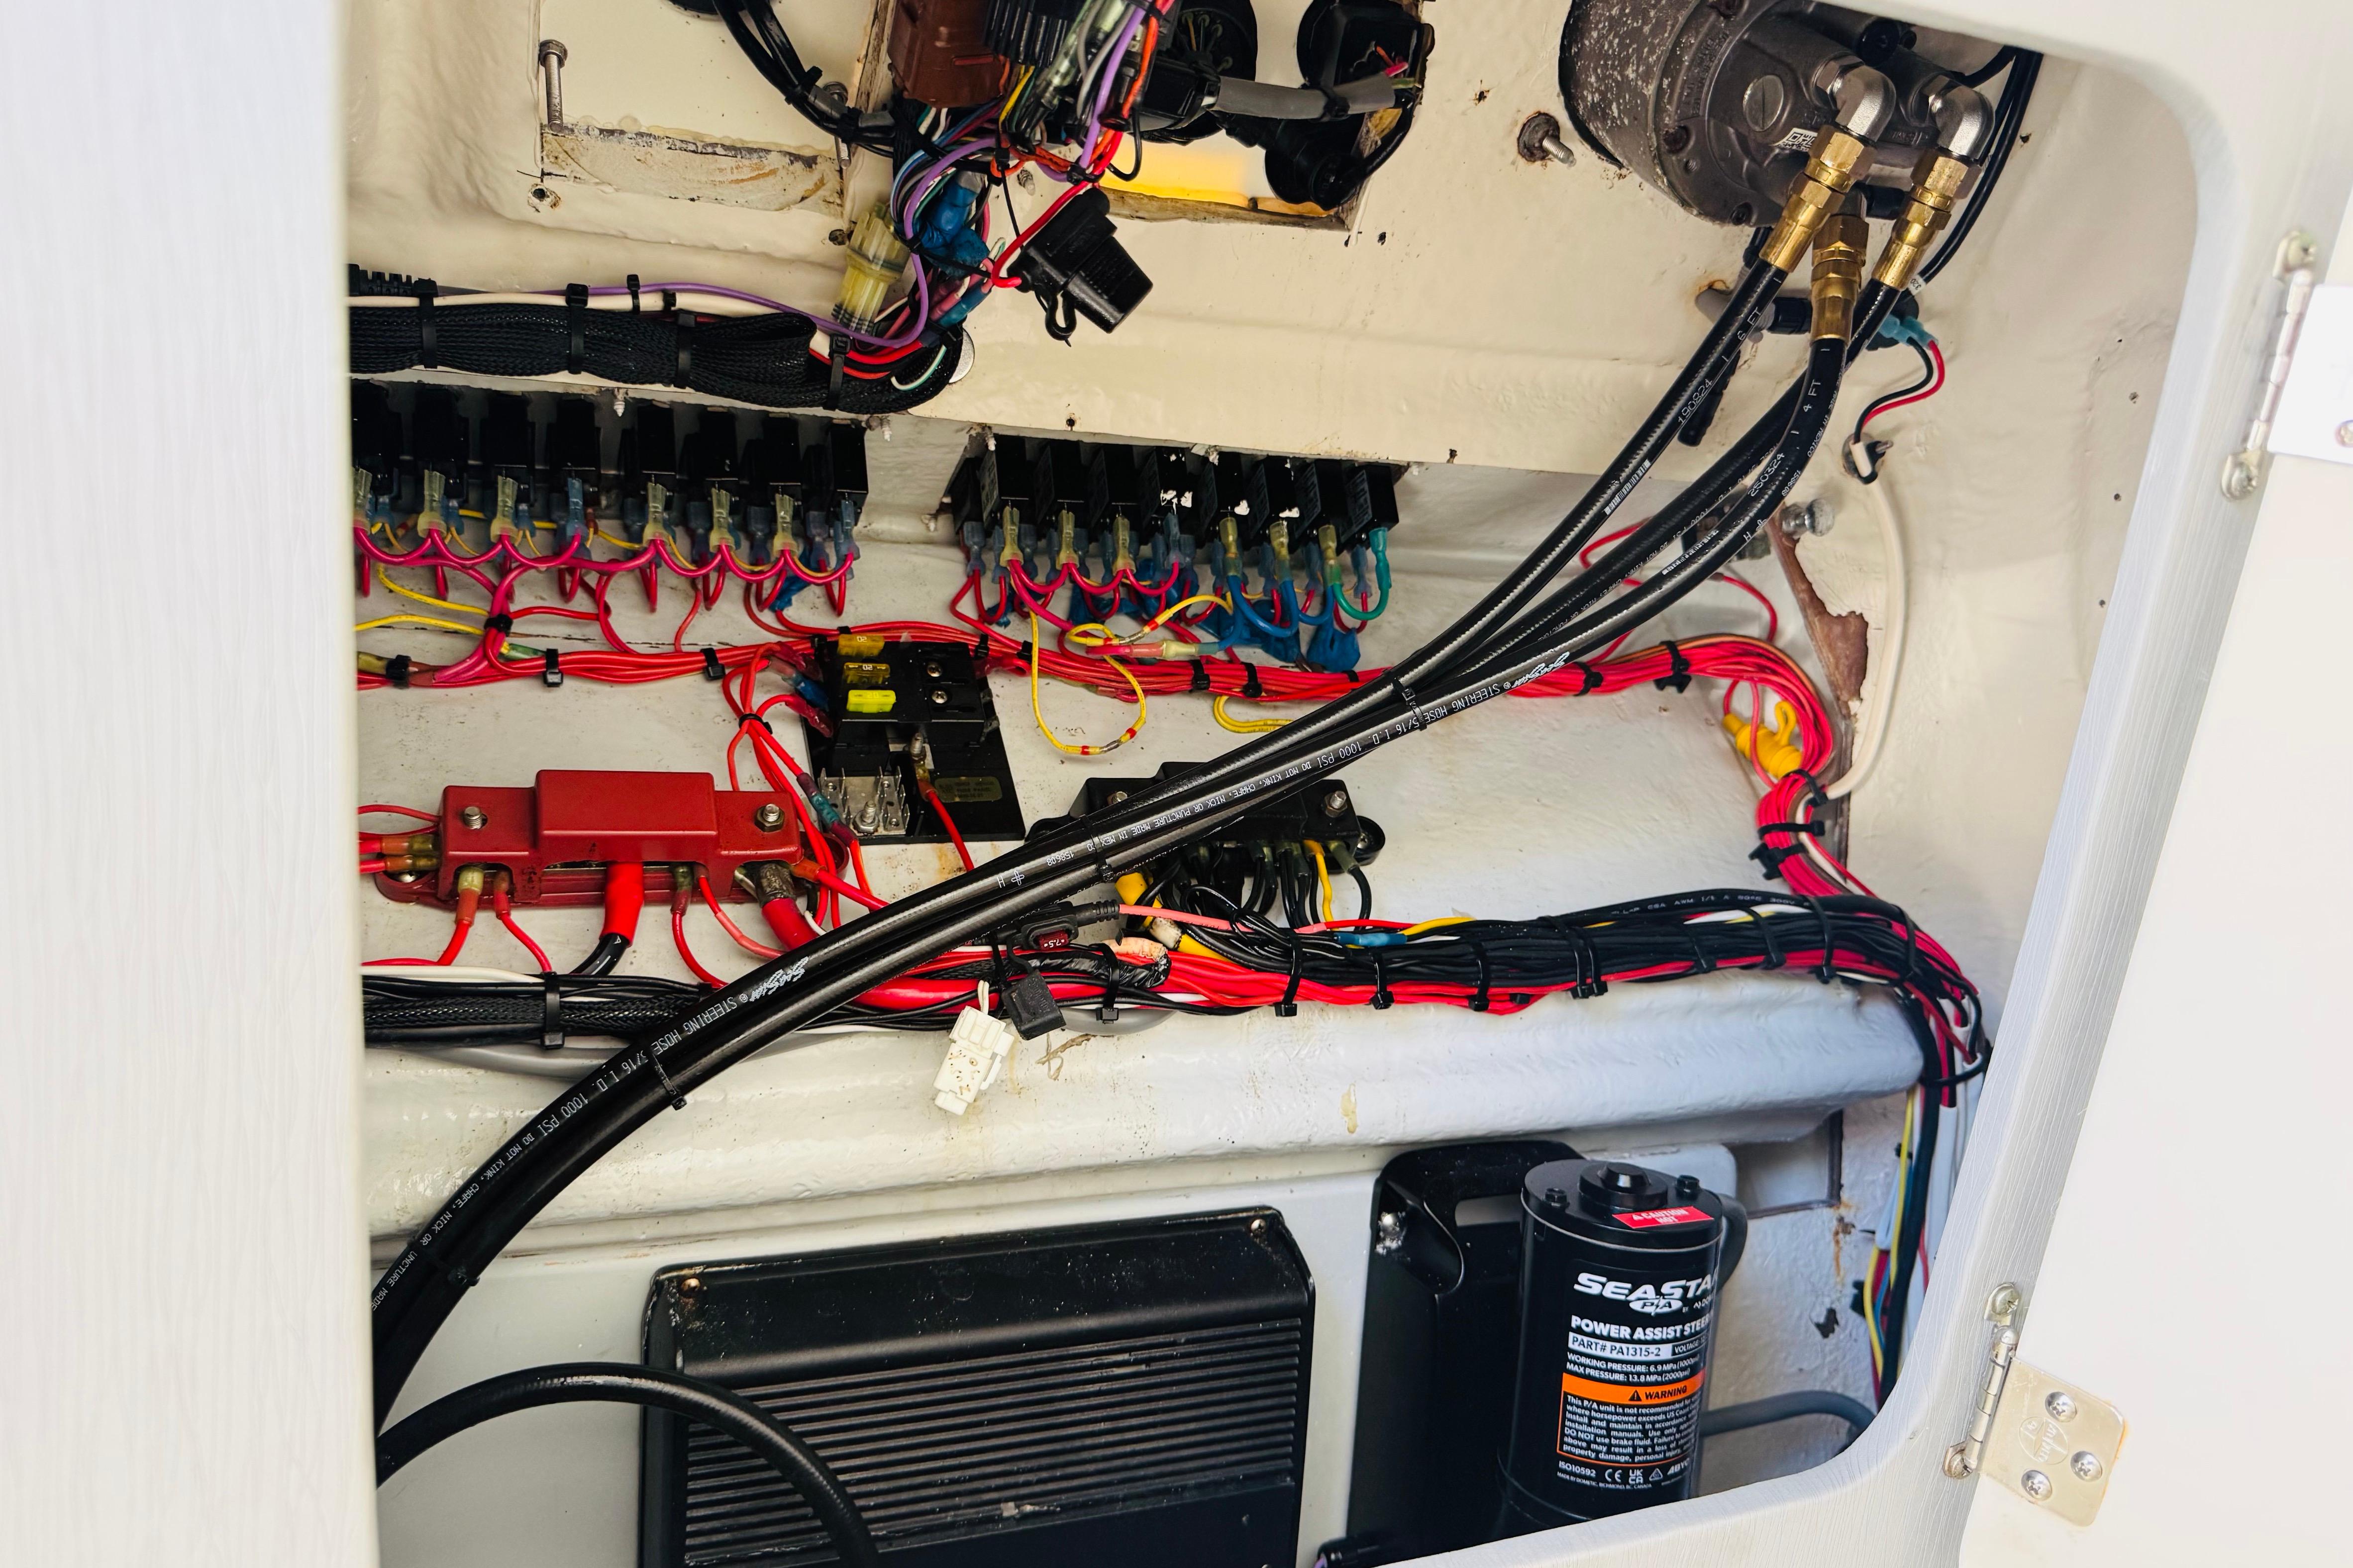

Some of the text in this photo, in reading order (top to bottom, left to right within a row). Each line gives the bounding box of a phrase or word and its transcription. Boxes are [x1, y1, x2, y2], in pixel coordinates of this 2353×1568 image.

[1678, 379, 1713, 424] 190824
[1747, 307, 1761, 325] FT
[1748, 453, 1785, 497] 250324
[1803, 403, 1812, 412] 4
[1808, 379, 1821, 396] FT
[1807, 427, 1825, 458] MEXICO
[1743, 531, 1753, 544] H
[1452, 684, 1500, 711] STEERING
[1423, 705, 1447, 723] HOSE
[1396, 717, 1420, 735] 5/16
[1368, 729, 1390, 745] I.D.
[1339, 741, 1361, 759] 1000
[1301, 762, 1312, 770] DO
[1318, 752, 1334, 768] PSI
[1259, 773, 1282, 787] KINK,
[1285, 767, 1299, 778] NOT
[1229, 784, 1255, 798] CHAFE,
[1194, 803, 1203, 813] OR
[1207, 797, 1226, 808] NICK
[1155, 807, 1191, 828] PUNCTURE
[1120, 832, 1128, 841] IN
[1131, 823, 1150, 836] MADE
[1046, 851, 1074, 866] 158608
[997, 875, 1006, 888] H
[1049, 938, 1062, 948] 7.5
[683, 996, 737, 1035] STEERING
[650, 1029, 682, 1055] HOSE
[592, 1071, 619, 1092] I.D.
[561, 1093, 588, 1118] 1000
[537, 1114, 560, 1137] PSI
[523, 1133, 535, 1145] DO
[506, 1143, 522, 1161] NOT
[481, 1159, 505, 1180] KINK,
[452, 1183, 479, 1208] CHAFE,
[431, 1211, 452, 1233] NICK
[1641, 1209, 1688, 1219] CAUTION
[420, 1233, 432, 1246] OR
[387, 1251, 418, 1287] UNCTURE
[1571, 1313, 1711, 1341] POWER ASSIST STEER
[1572, 1336, 1661, 1357] PART# PA1315-2
[1567, 1352, 1606, 1368] WORKING
[1607, 1362, 1648, 1372] PRESSURE:
[1662, 1362, 1676, 1371] MPa
[1567, 1361, 1584, 1374] MAX
[1585, 1368, 1627, 1381] PRESSURE:
[1645, 1373, 1662, 1382] MPa
[1662, 1368, 1690, 1381] (2000psi)
[1644, 1385, 1687, 1400] WARNING
[1567, 1395, 1582, 1405] This
[1583, 1399, 1598, 1410] P/A
[1600, 1403, 1615, 1412] unit
[1639, 1399, 1684, 1414] recommended
[1567, 1404, 1590, 1416] where
[1592, 1410, 1637, 1422] horsepower
[1638, 1413, 1665, 1422] exceeds
[1565, 1420, 1606, 1435] installation
[1611, 1429, 1644, 1438] manuals.
[1664, 1427, 1676, 1436] only
[1566, 1411, 1588, 1423] Install
[1591, 1418, 1606, 1427] and
[1610, 1421, 1642, 1430] maintain
[1654, 1415, 1686, 1429] accordance
[1564, 1427, 1576, 1436] DO
[1578, 1431, 1595, 1440] NOT
[1596, 1435, 1609, 1443] use
[1611, 1436, 1633, 1446] brake
[1634, 1437, 1652, 1446] fluid.
[1654, 1433, 1675, 1444] Failure
[1564, 1436, 1587, 1448] above
[1591, 1443, 1607, 1453] may
[1611, 1445, 1633, 1454] result
[1655, 1443, 1667, 1452] loss
[1563, 1444, 1596, 1458] property
[1599, 1453, 1632, 1463] damage,
[1635, 1453, 1663, 1463] personal
[1558, 1460, 1596, 1477] ISO10592
